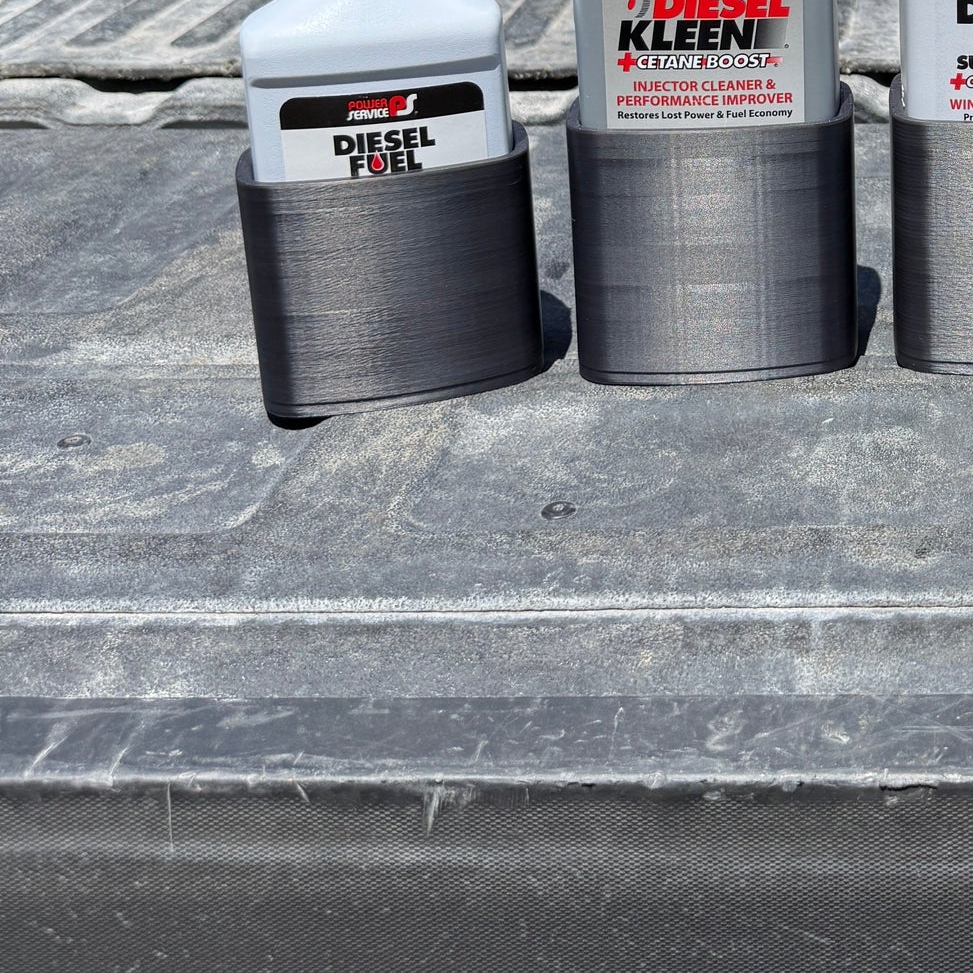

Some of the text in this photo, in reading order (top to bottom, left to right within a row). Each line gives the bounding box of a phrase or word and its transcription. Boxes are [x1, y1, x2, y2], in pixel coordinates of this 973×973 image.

[617, 19, 755, 52] KLEEN
[704, 53, 771, 69] BOOST
[633, 78, 776, 92] INJECTOR CLEANER &
[347, 97, 389, 111] POWER
[616, 92, 793, 107] PERFORMANCE IMPROVER
[346, 107, 390, 121] SERVICE
[617, 109, 793, 121] Restores Lost Power & Fuel Economy
[333, 125, 436, 157] DIESEL
[349, 149, 424, 177] FUEL
